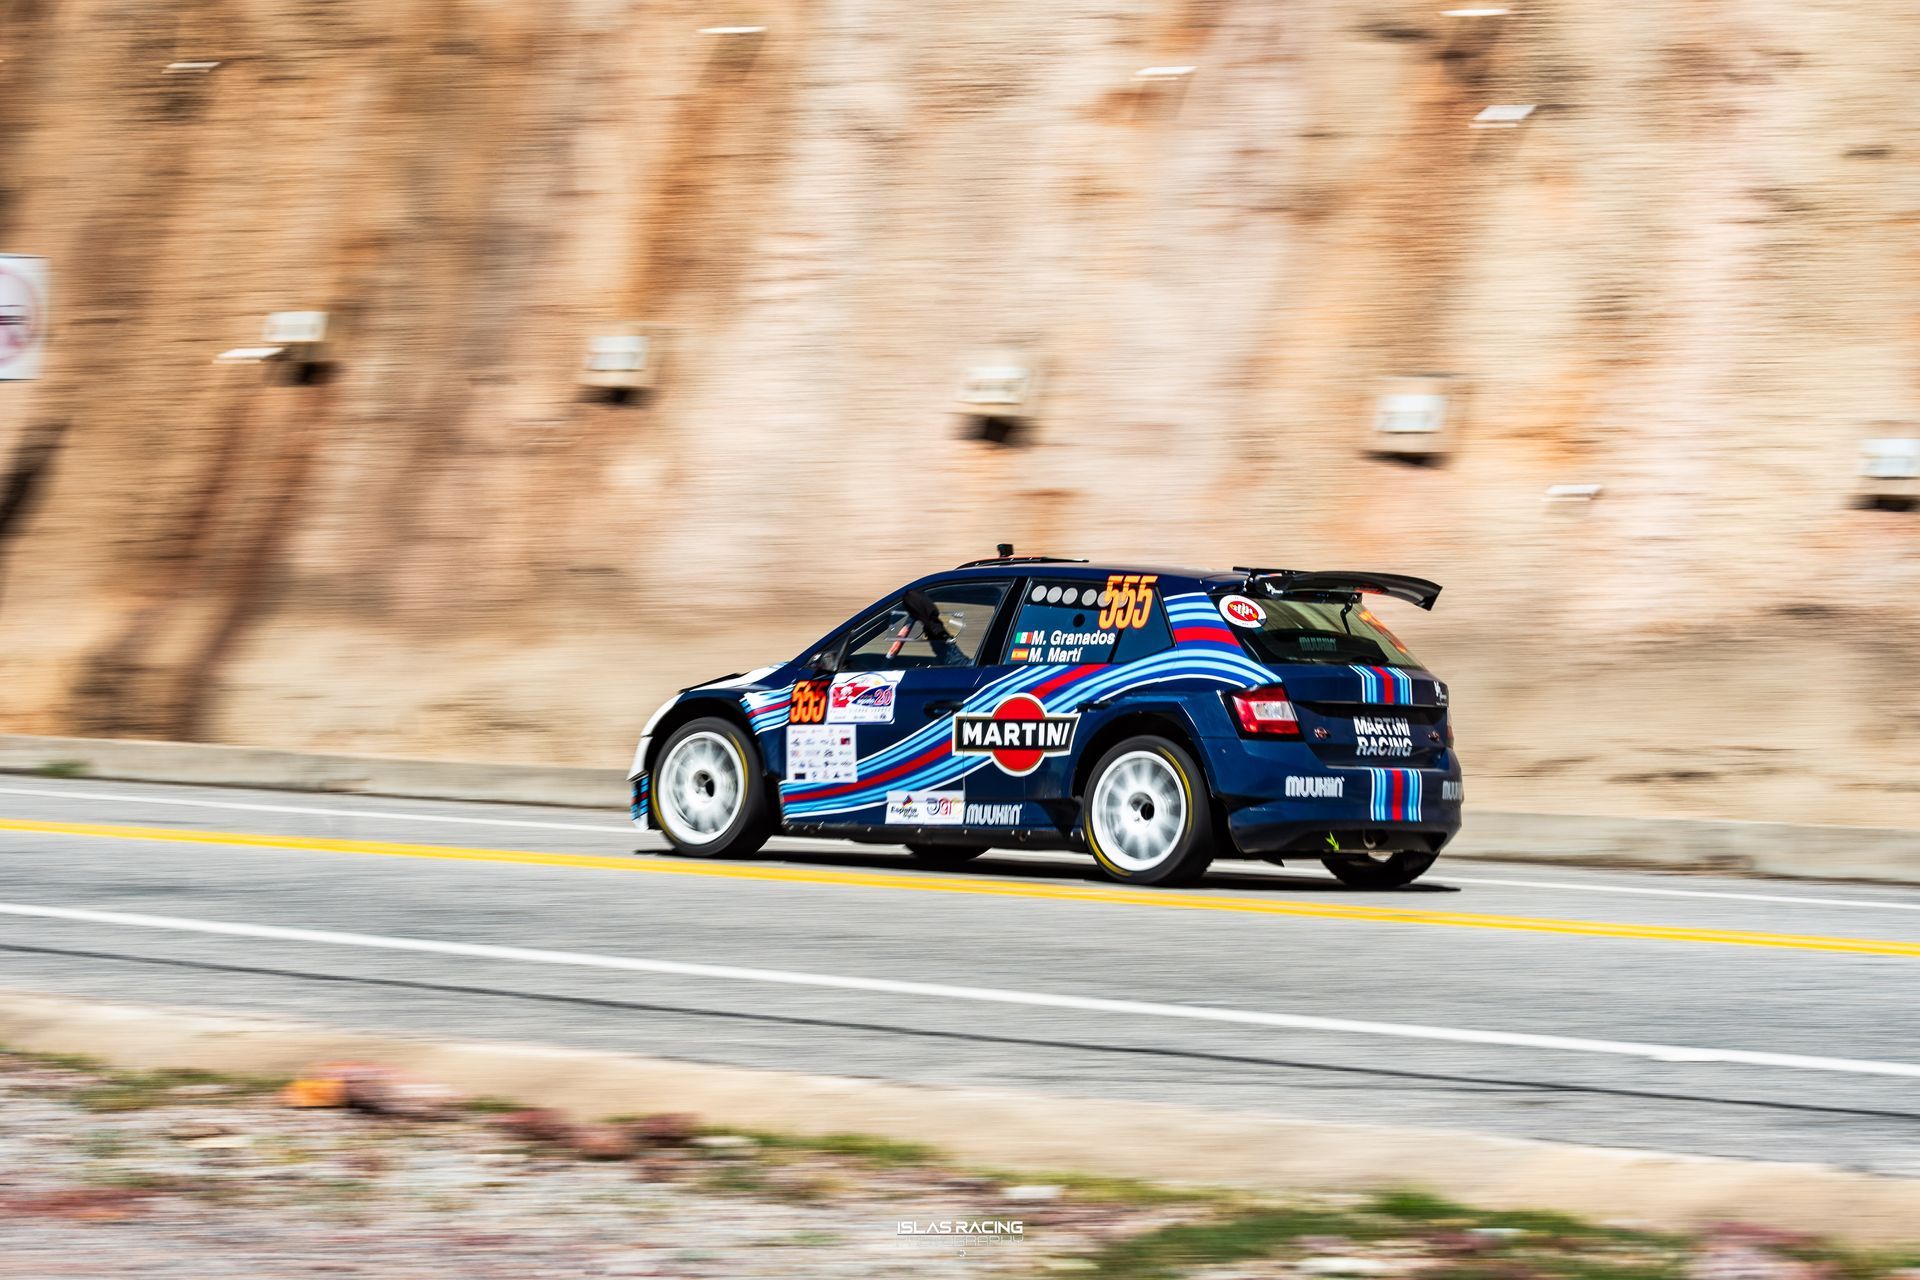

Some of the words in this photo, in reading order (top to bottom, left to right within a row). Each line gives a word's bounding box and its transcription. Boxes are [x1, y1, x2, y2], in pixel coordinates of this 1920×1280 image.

[1098, 575, 1158, 629] 555
[1031, 631, 1047, 645] M.
[1050, 630, 1116, 645] Granados
[1027, 648, 1044, 662] M.
[789, 680, 829, 723] 555
[963, 722, 1071, 746] MARTINI
[1353, 716, 1411, 736] MARTINI
[1356, 736, 1413, 757] RACING
